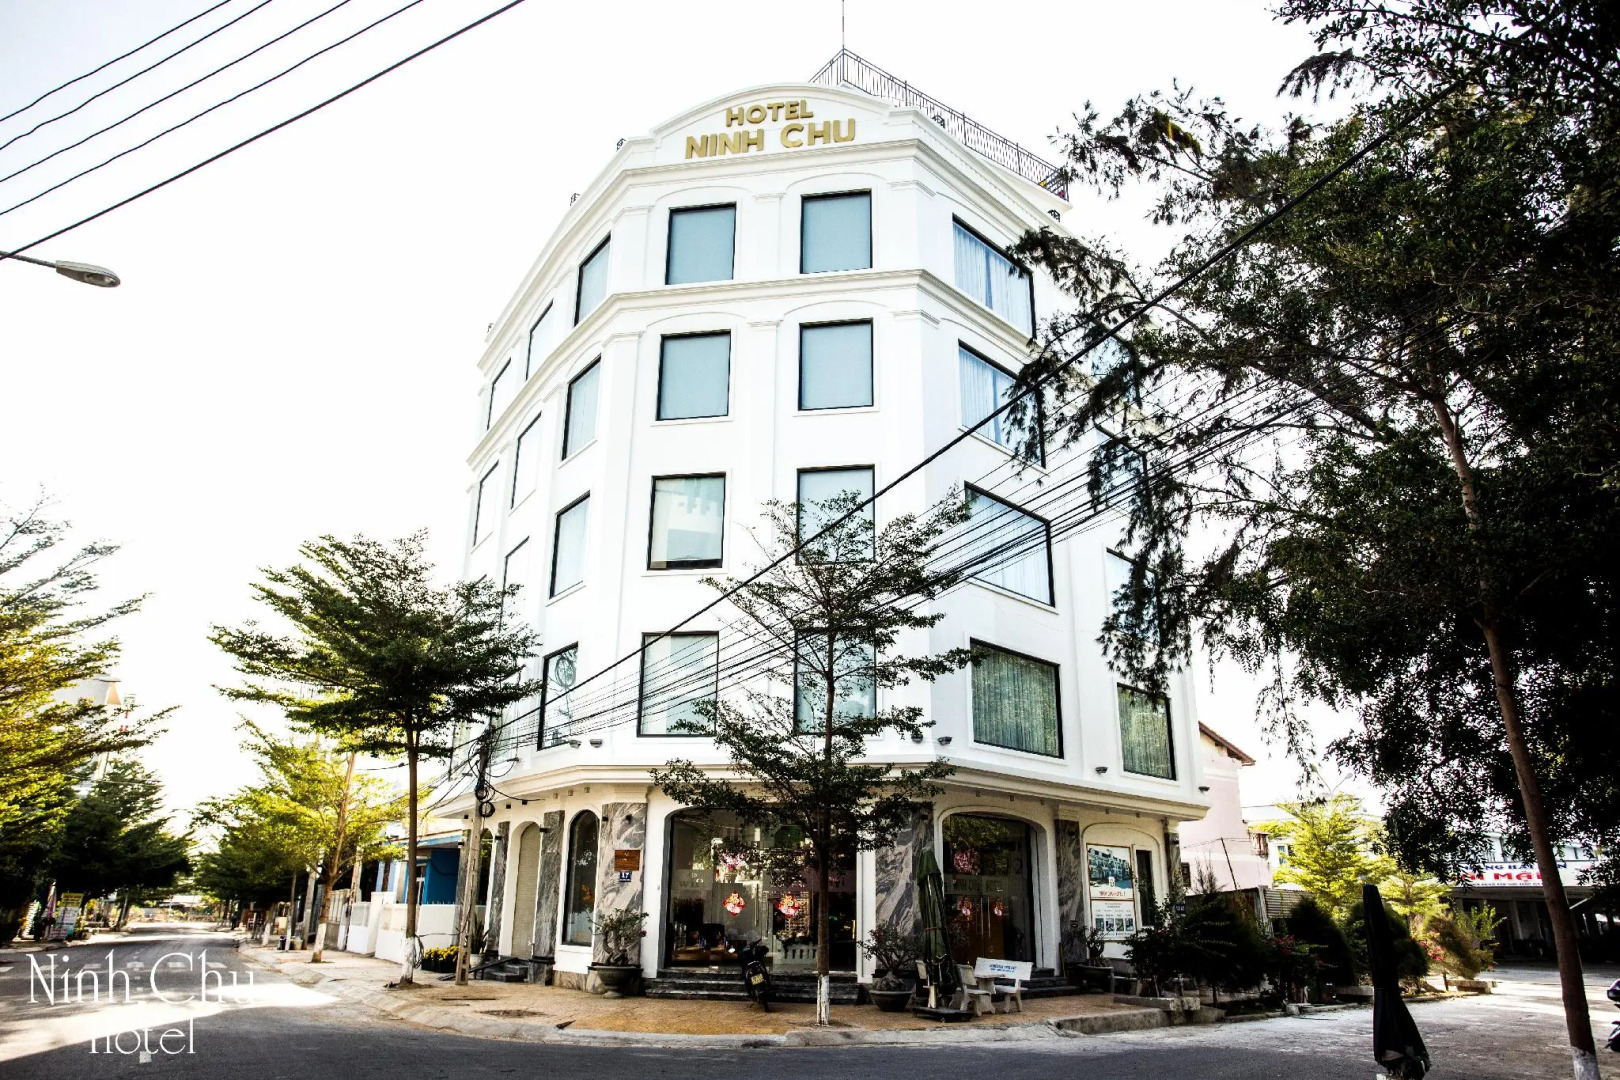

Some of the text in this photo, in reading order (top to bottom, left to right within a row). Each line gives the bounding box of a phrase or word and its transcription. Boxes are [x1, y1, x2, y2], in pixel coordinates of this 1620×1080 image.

[725, 100, 814, 127] HOTEL
[685, 118, 856, 159] NINH CHU
